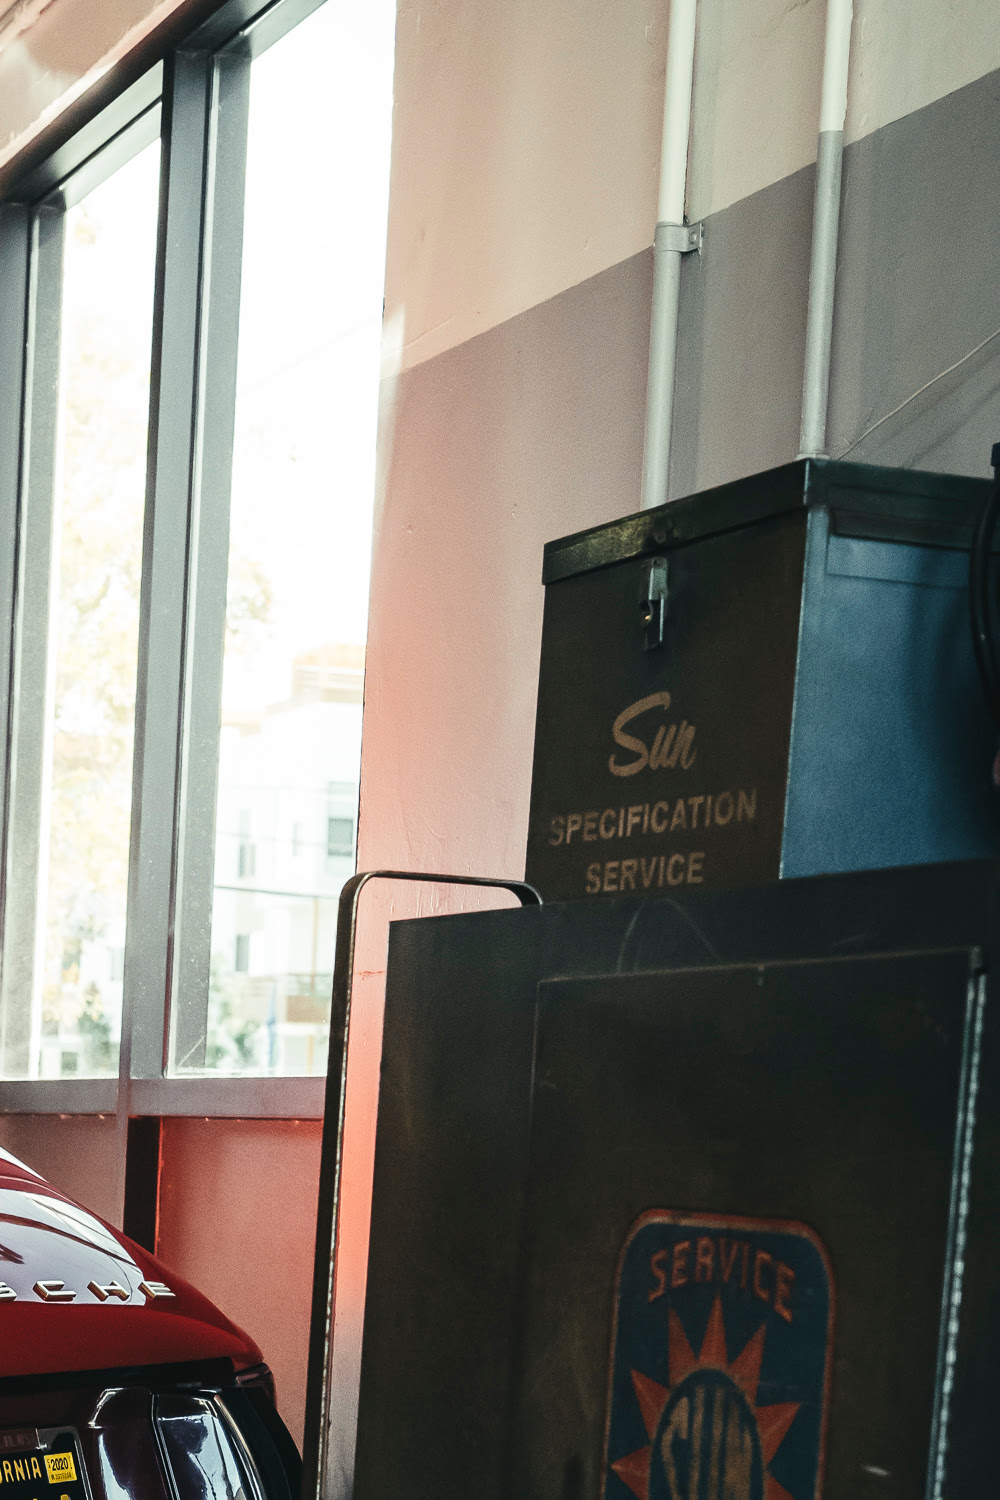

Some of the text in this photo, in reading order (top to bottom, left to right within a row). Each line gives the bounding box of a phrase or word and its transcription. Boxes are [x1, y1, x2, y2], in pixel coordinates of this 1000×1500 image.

[608, 691, 697, 777] Sun
[549, 788, 758, 847] SPECIFICATION
[585, 851, 706, 894] SERVICE
[648, 1236, 796, 1323] SERVICE
